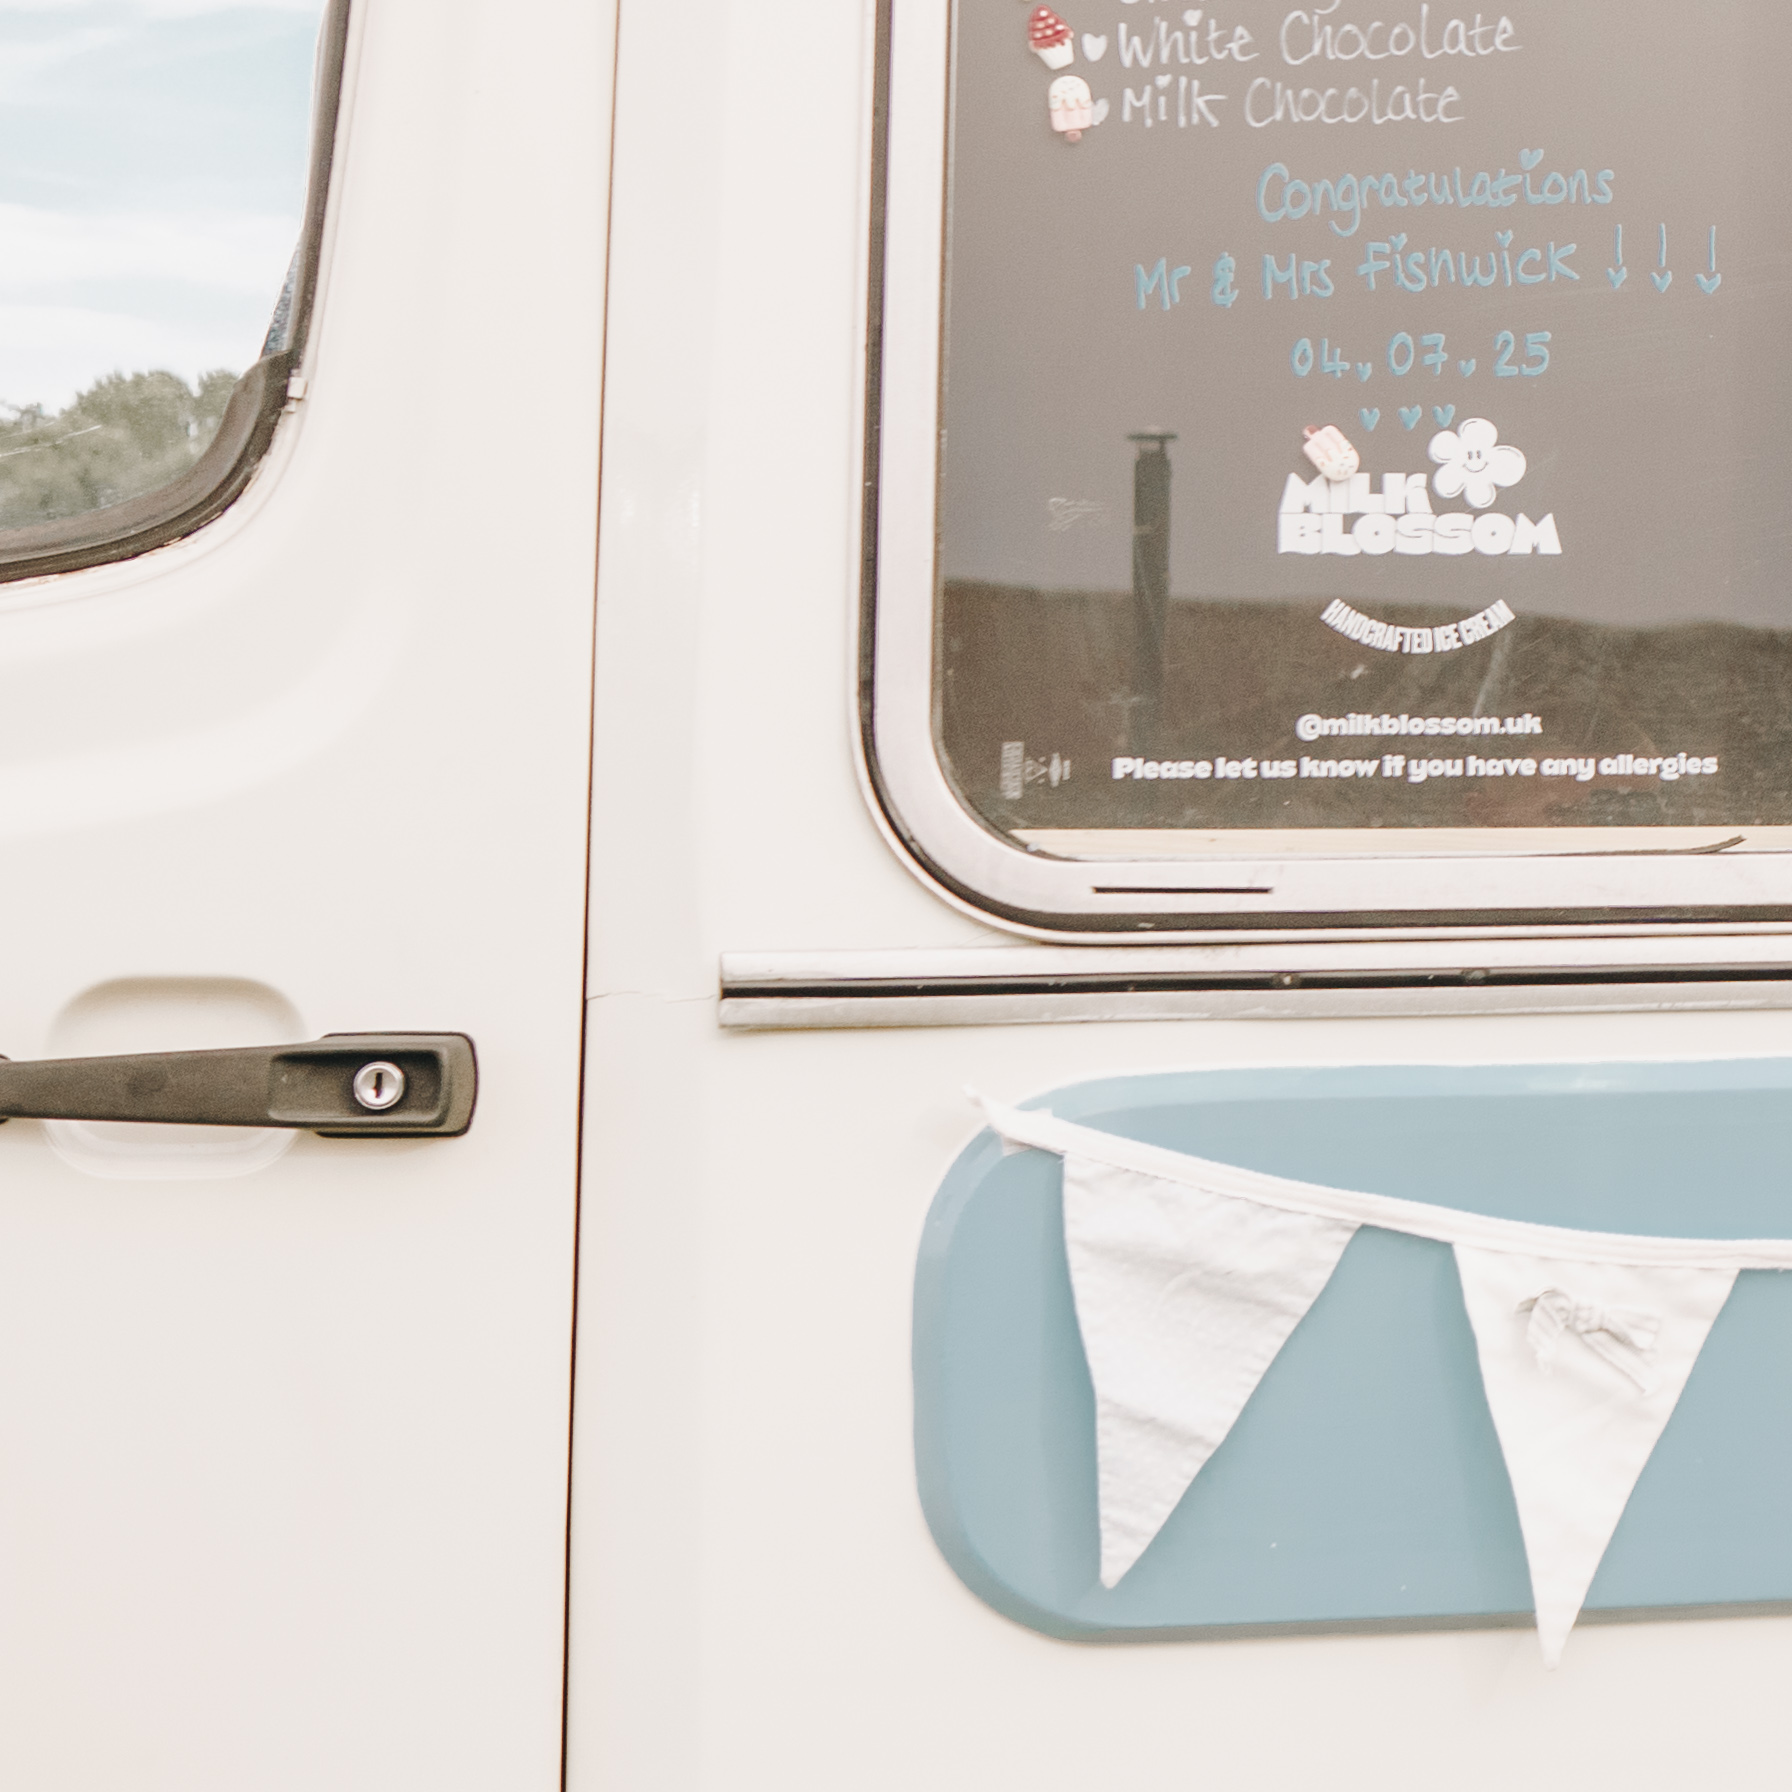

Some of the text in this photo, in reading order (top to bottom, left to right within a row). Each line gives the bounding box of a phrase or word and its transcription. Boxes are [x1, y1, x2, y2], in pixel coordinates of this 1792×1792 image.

[1117, 3, 1524, 69] White Chocolate
[1122, 74, 1466, 128] Milk Chocolate
[1256, 148, 1615, 238] Congratulations
[1134, 230, 1580, 311] Mr & Mrs Fishwick
[1279, 472, 1434, 514] MILK
[1277, 512, 1563, 555] BLOSSOM
[1319, 598, 1517, 655] HANDCRAFTED ICE CREAM
[1295, 713, 1544, 742] @milkblossom.uk
[1111, 752, 1719, 784] Please let us know if you have any allergies
